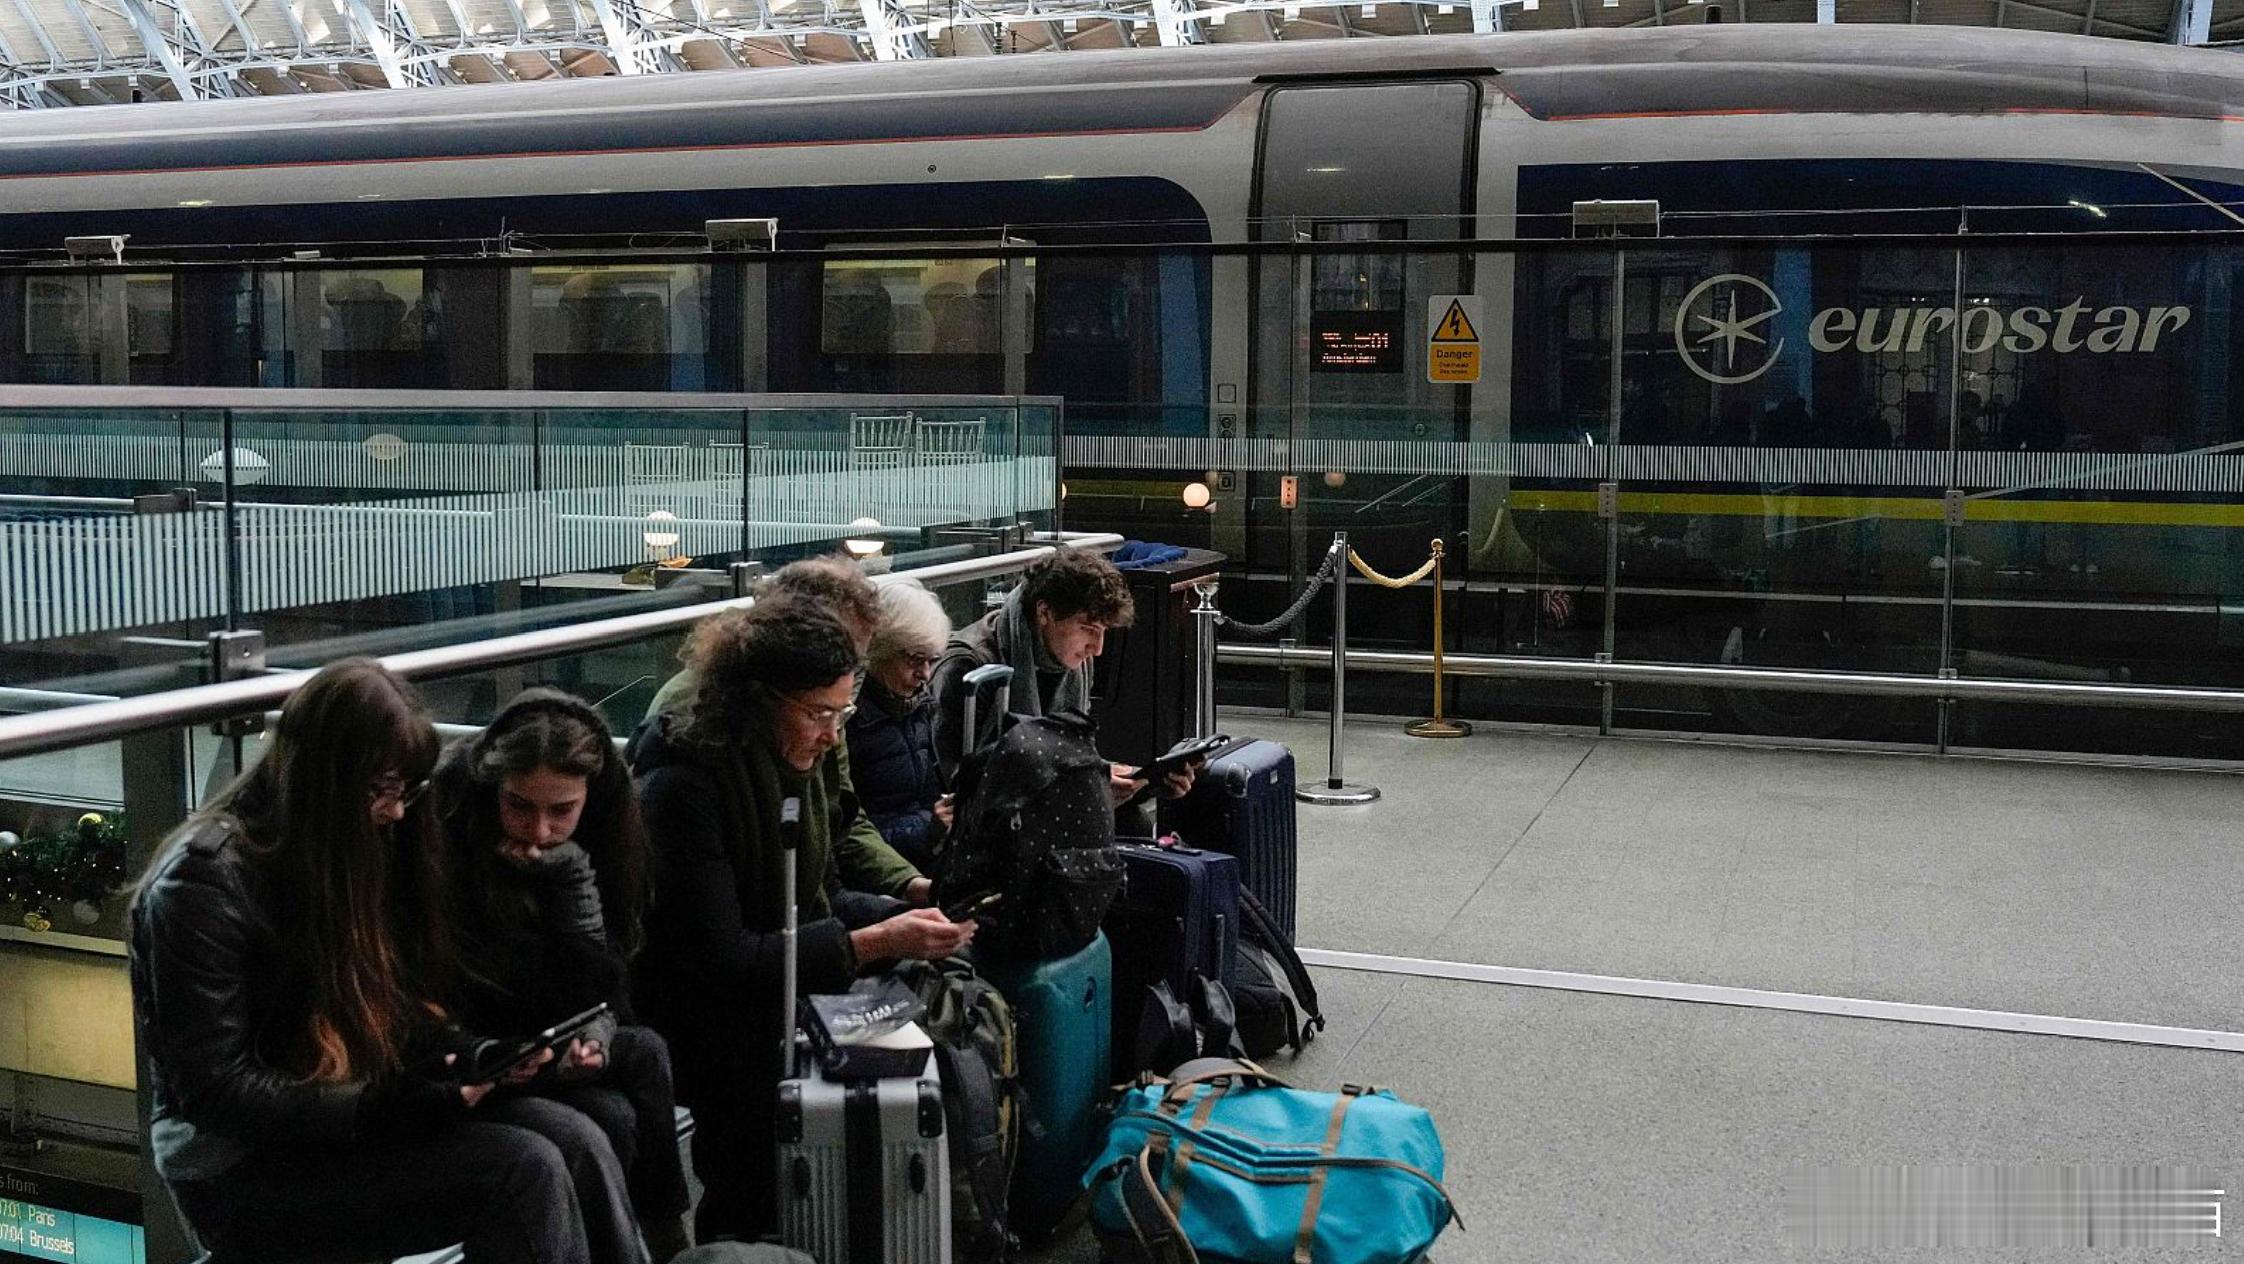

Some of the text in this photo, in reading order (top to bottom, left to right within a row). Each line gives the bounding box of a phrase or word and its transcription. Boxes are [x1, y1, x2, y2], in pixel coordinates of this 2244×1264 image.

[1808, 294, 2191, 353] eurostar
[1436, 349, 1473, 360] Danger
[7, 1173, 39, 1196] from:
[28, 1204, 56, 1227] Paris
[29, 1229, 75, 1254] Brussels
